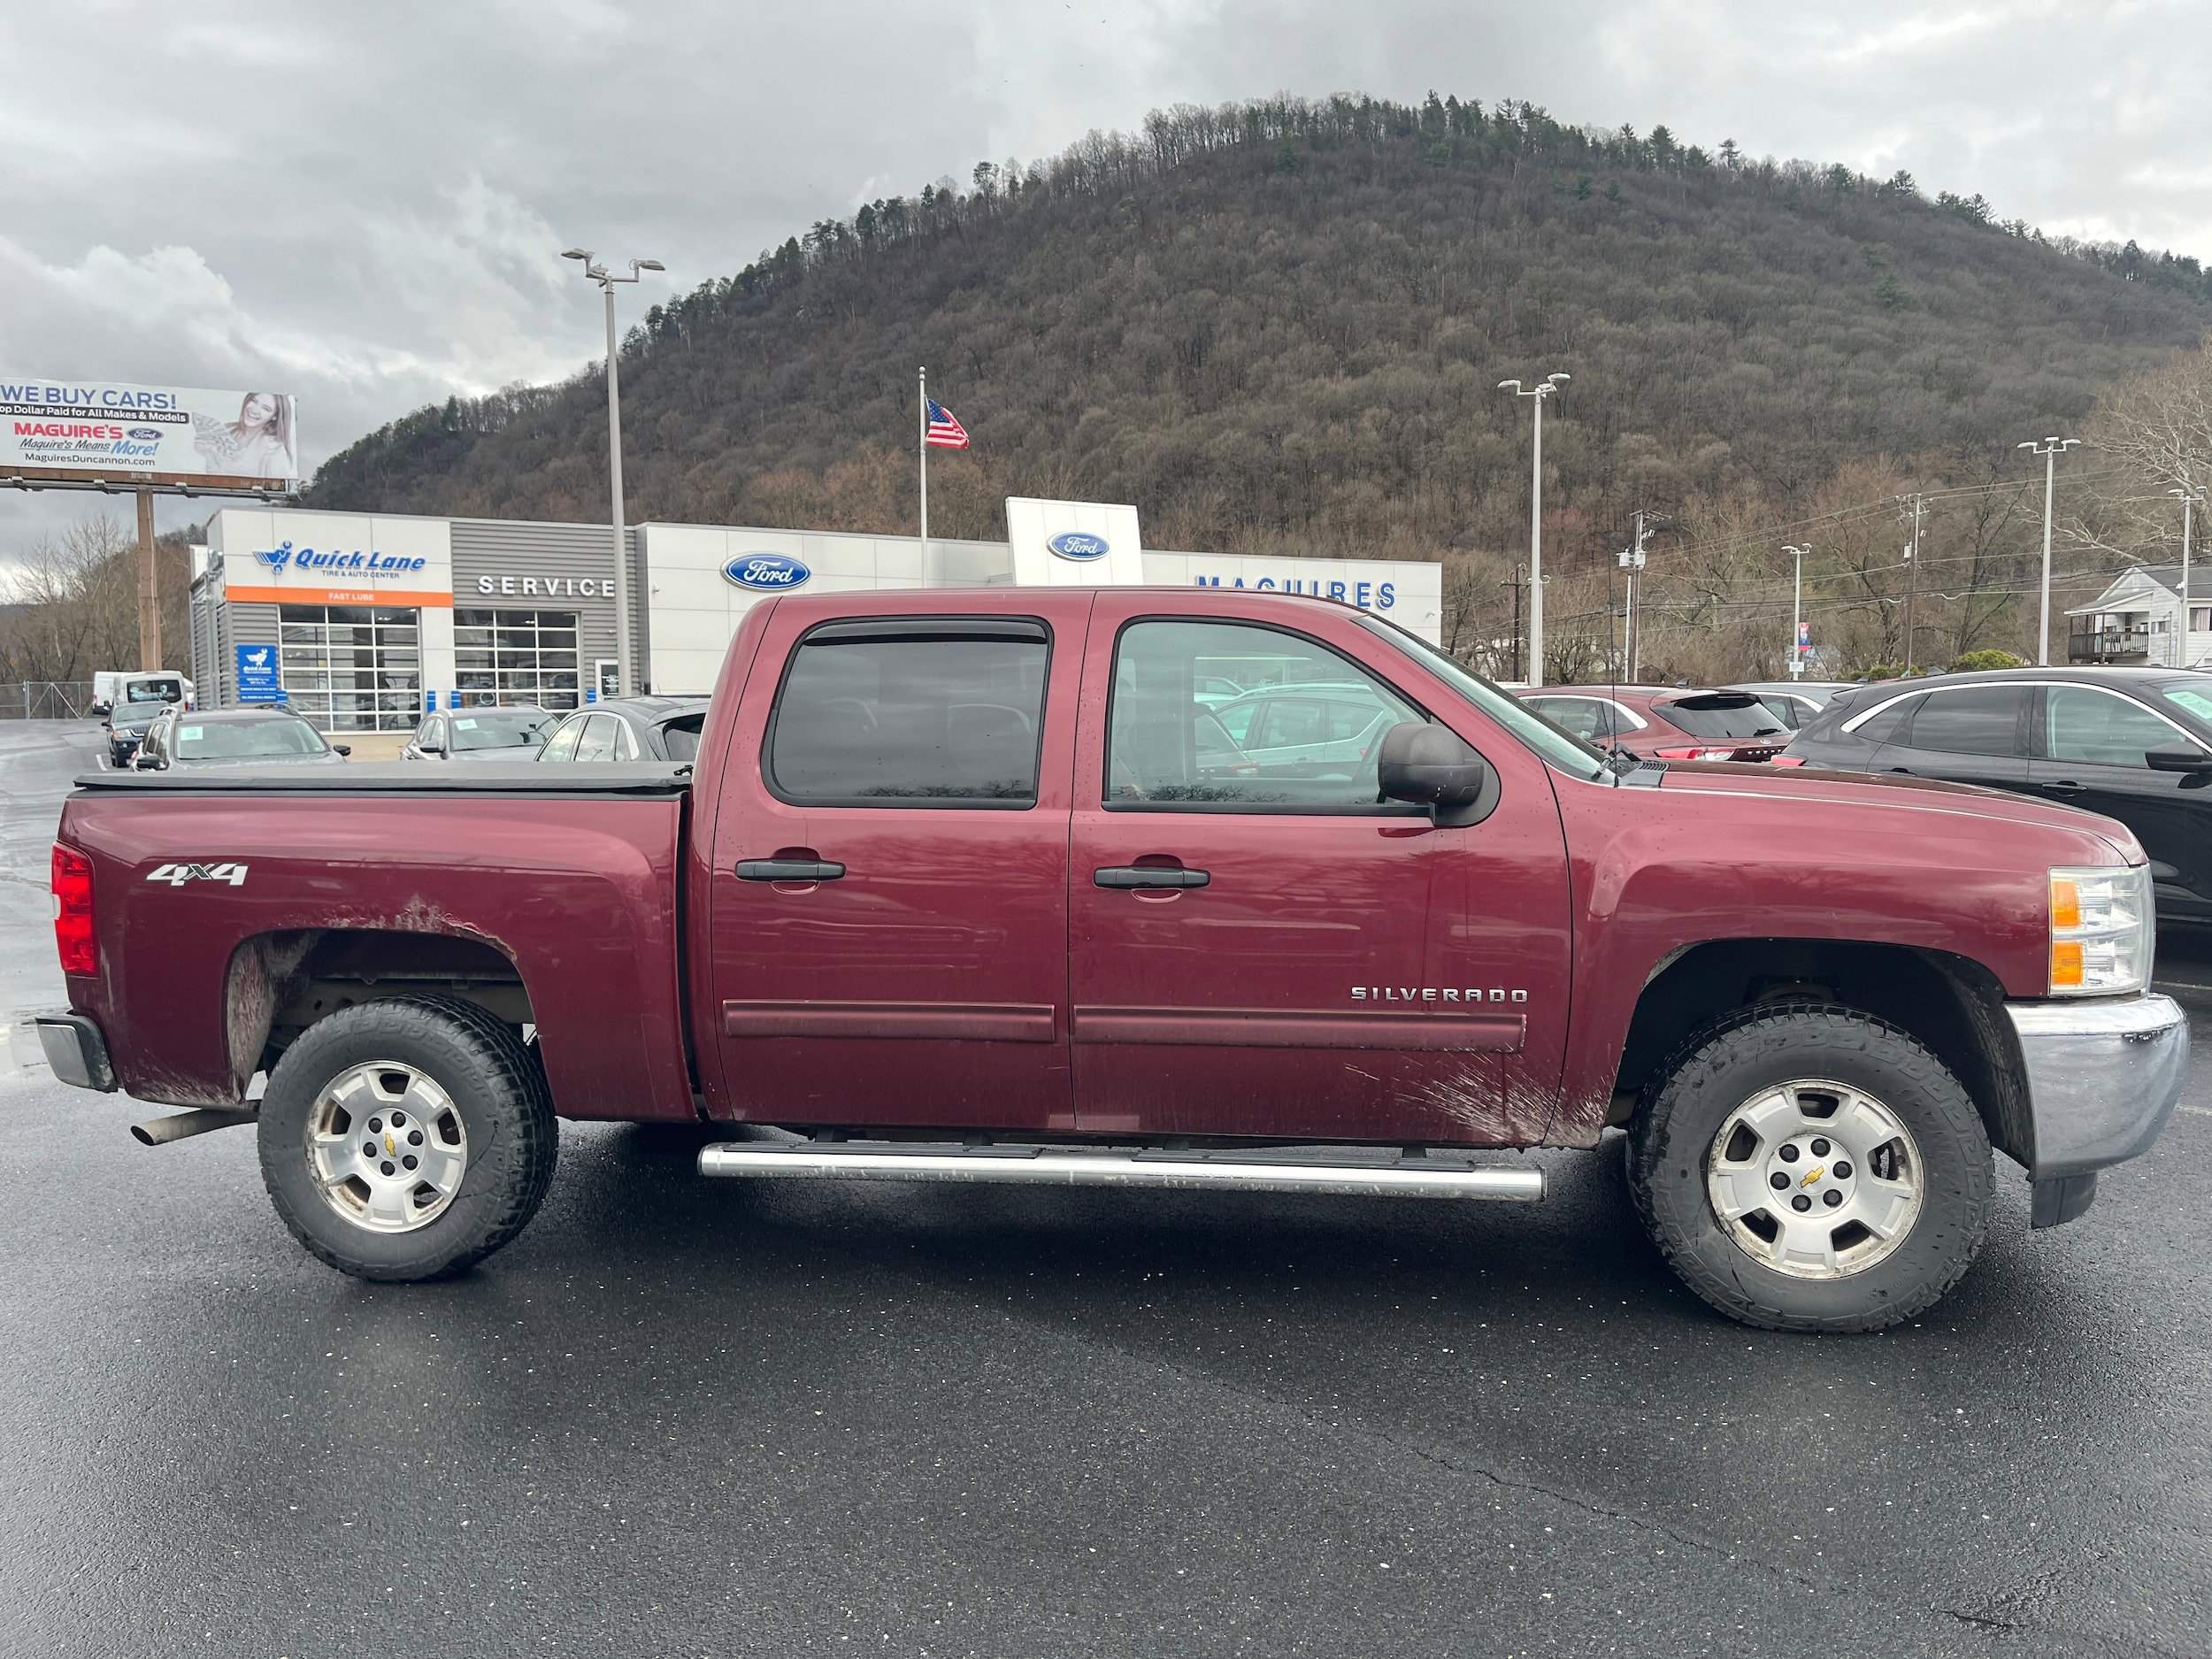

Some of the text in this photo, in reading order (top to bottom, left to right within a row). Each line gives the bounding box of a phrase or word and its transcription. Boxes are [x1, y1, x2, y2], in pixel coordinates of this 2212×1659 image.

[0, 385, 177, 410] WE BUY CARS!
[0, 405, 186, 422] op Dollar Paid for All Makes & Models
[14, 422, 123, 439] MAGUIRE'S
[133, 429, 157, 440] Ford
[19, 438, 159, 456] Maguire's Means More!
[25, 453, 156, 466] MaguiresDuncannon.com
[1064, 536, 1098, 554] Ford
[295, 549, 426, 570] Quick Lane
[744, 560, 794, 582] Ford
[478, 575, 615, 597] SERVICE
[1351, 987, 1528, 1002] SILVERADO
